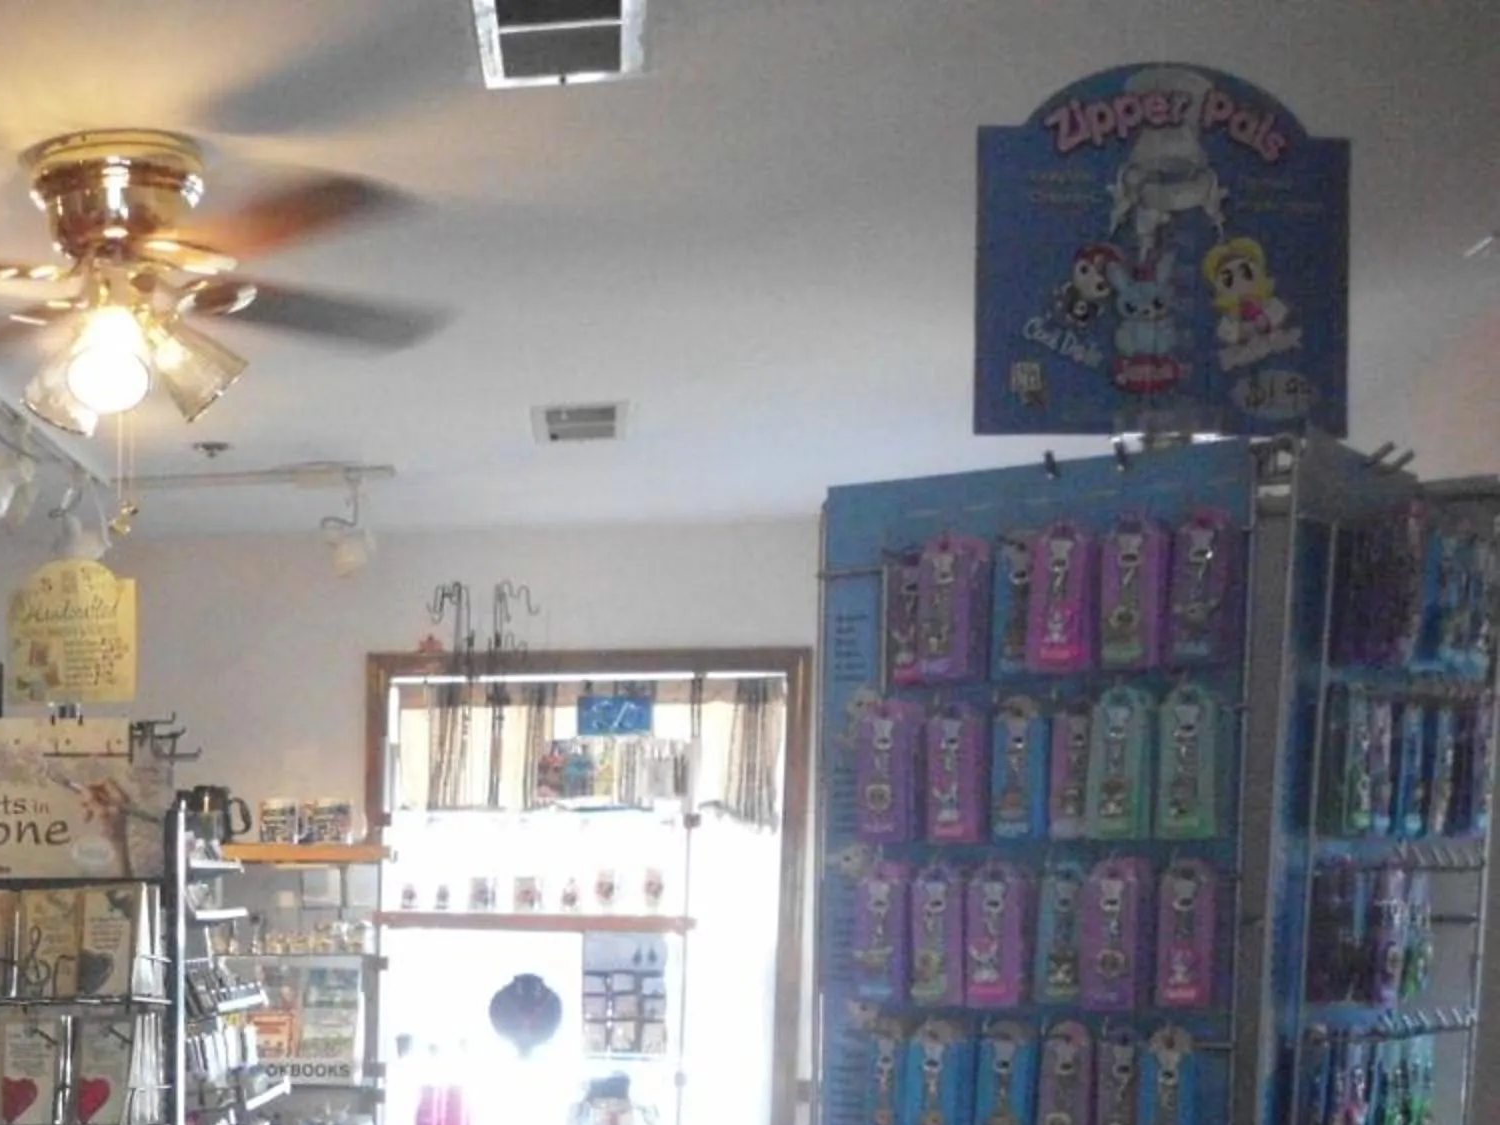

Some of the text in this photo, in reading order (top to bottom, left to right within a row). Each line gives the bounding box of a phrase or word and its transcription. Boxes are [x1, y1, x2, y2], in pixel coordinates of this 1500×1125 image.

[1045, 91, 1194, 152] Zipper
[33, 799, 50, 815] in
[266, 1063, 350, 1078] OKBOOKS
